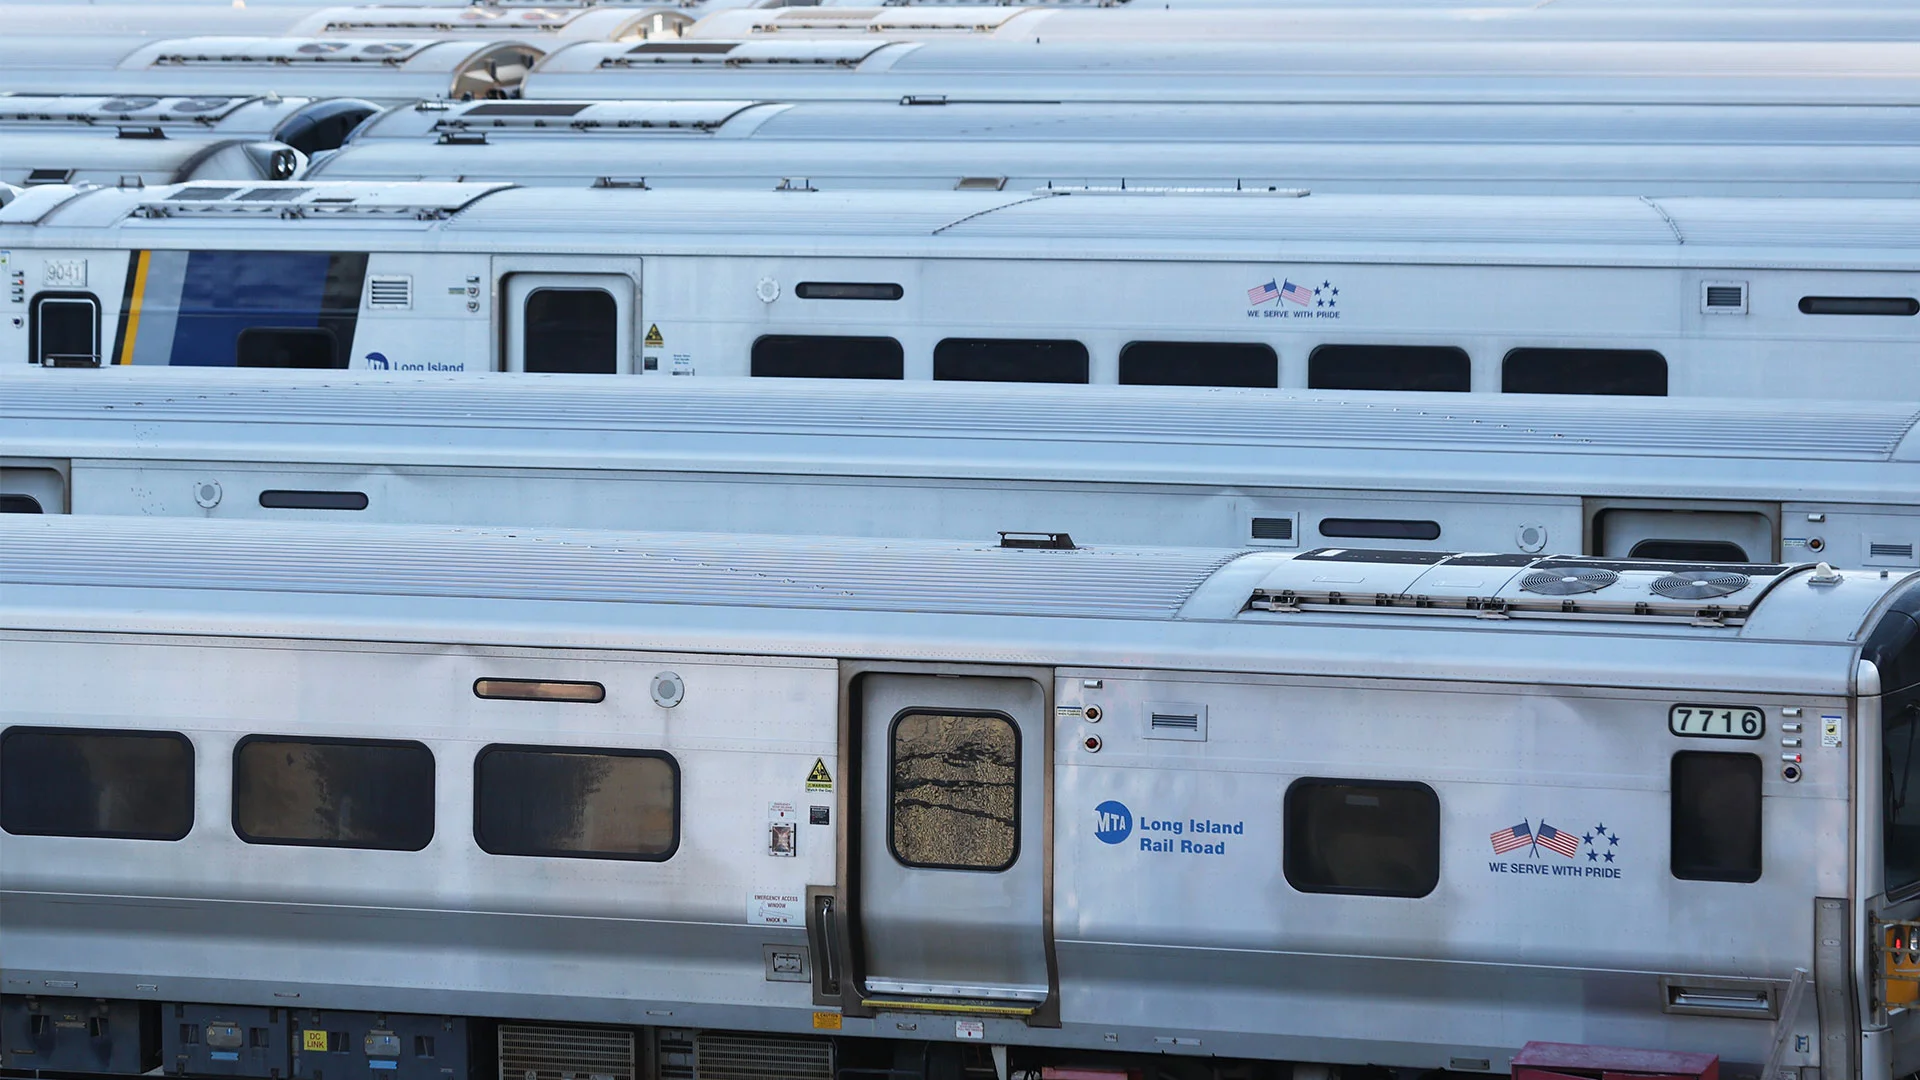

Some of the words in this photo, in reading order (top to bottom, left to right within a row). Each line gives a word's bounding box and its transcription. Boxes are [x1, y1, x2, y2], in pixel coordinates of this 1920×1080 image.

[47, 264, 80, 281] 9041
[1263, 310, 1289, 318] SERVE
[1293, 310, 1313, 318] WITH
[1316, 311, 1340, 319] PRIDE
[428, 362, 464, 372] Island
[1677, 709, 1757, 734] 7716
[1093, 810, 1126, 833] MTA
[1140, 817, 1183, 834] Long
[1189, 819, 1244, 835] Island
[1140, 838, 1174, 852] Rail
[1181, 840, 1225, 855] Road
[1489, 863, 1508, 872] WE
[1510, 864, 1549, 875] SERVE
[1552, 866, 1582, 876] WITH
[1585, 867, 1621, 878] PRIDE
[1798, 1036, 1806, 1050] F
